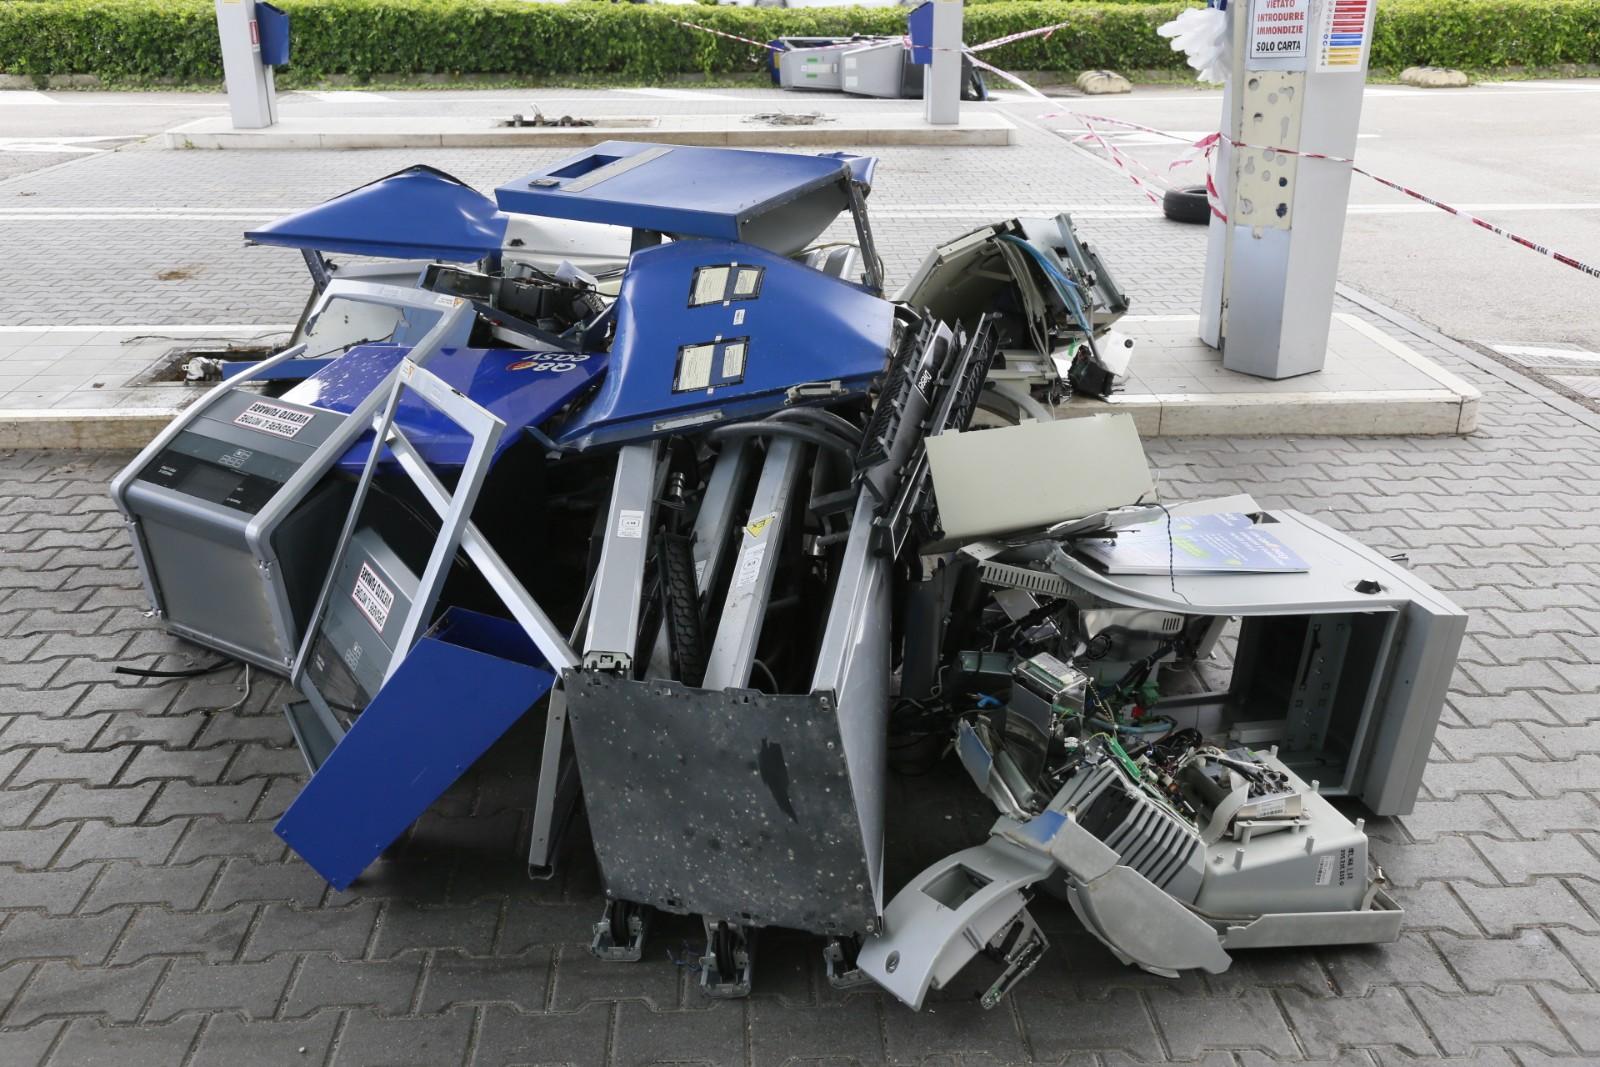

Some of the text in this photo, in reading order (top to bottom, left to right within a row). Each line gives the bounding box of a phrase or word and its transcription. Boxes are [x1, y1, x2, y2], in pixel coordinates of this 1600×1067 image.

[1266, 0, 1296, 8] VIETATO
[1257, 12, 1304, 22] INTRODURRE
[1257, 25, 1303, 35] IMMONDIZIE
[1256, 41, 1301, 51] SOLO CARTA
[522, 352, 591, 362] easy
[533, 362, 577, 372] Q8
[249, 403, 310, 424] VIETATO FUMARE
[360, 566, 392, 609] VIETATO FUMARE
